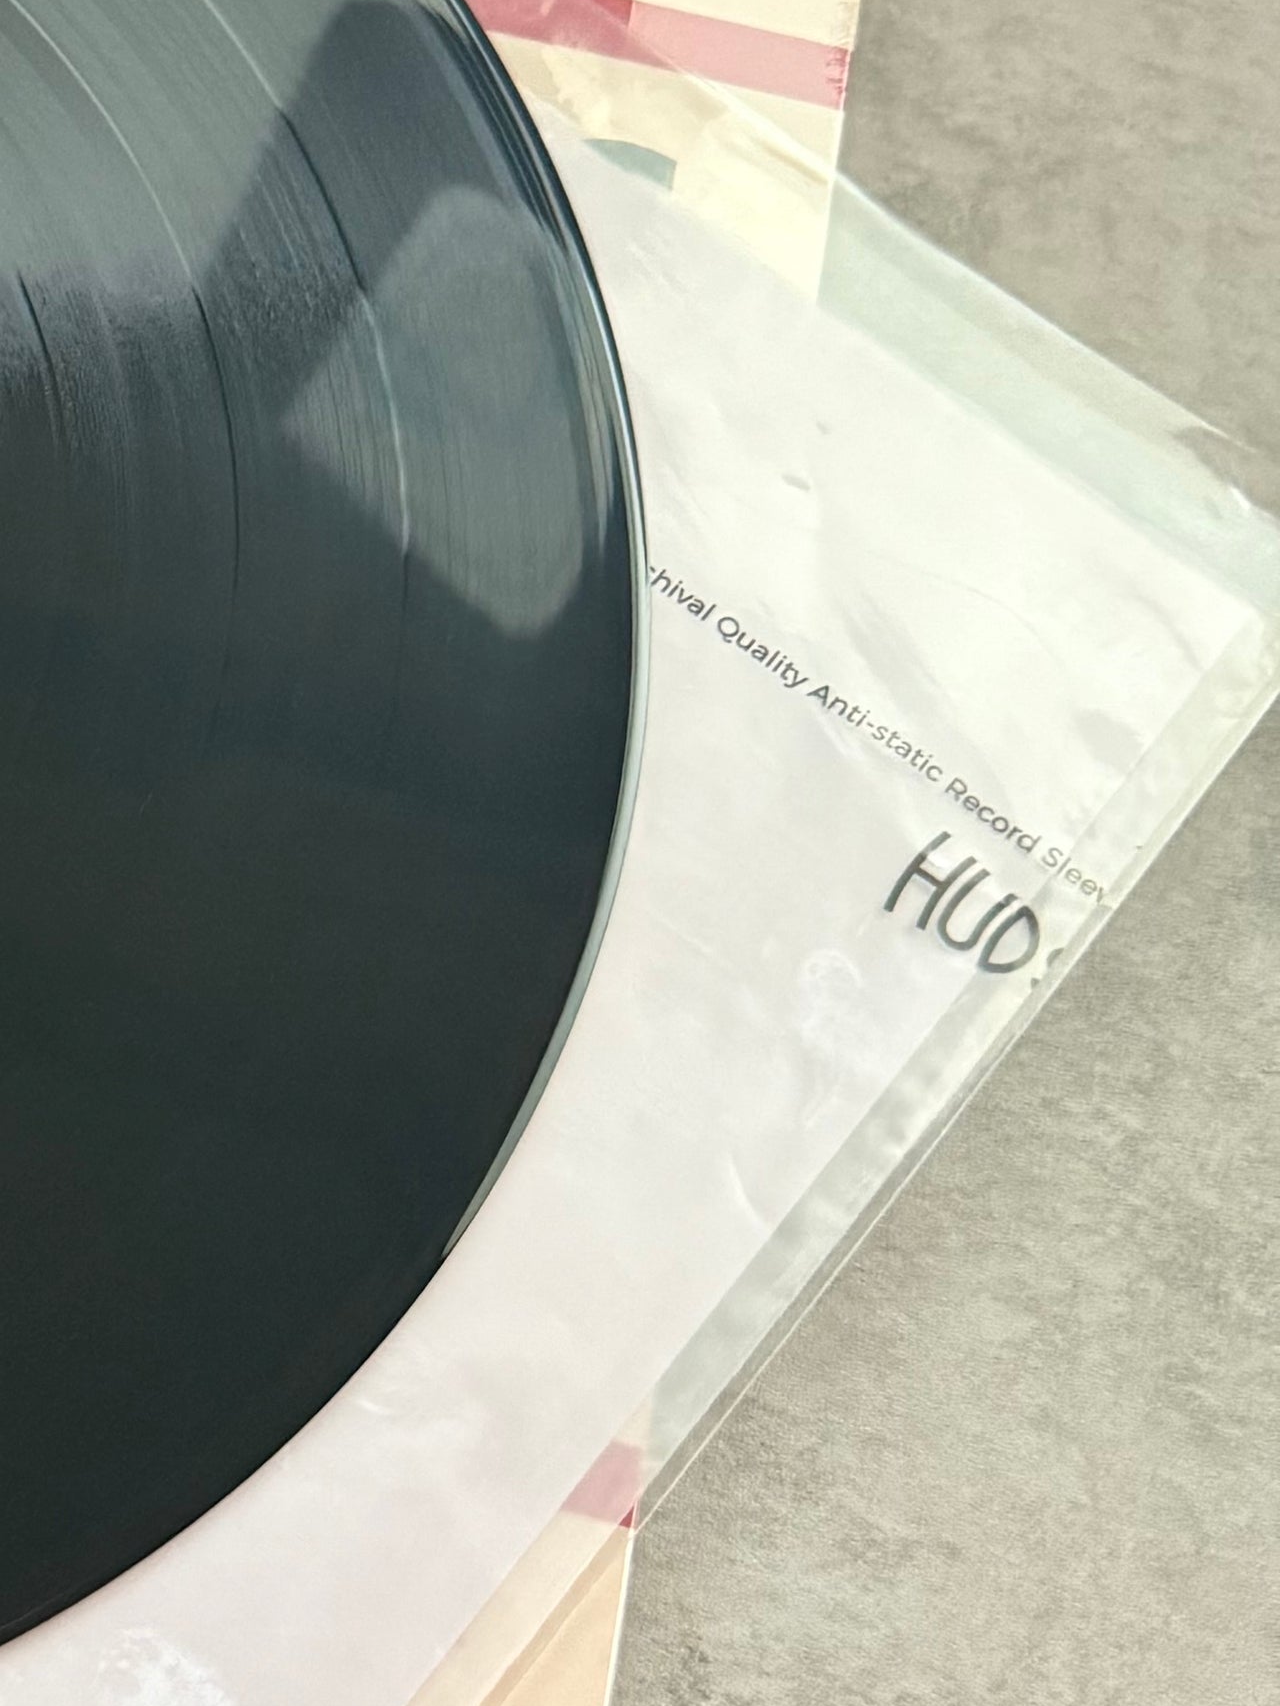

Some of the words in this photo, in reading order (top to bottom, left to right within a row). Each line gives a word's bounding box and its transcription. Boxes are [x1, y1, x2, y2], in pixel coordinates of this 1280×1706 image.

[648, 565, 717, 621] hival
[717, 616, 809, 688] Quality
[807, 685, 943, 782] Anti-static
[944, 777, 1042, 853] Record
